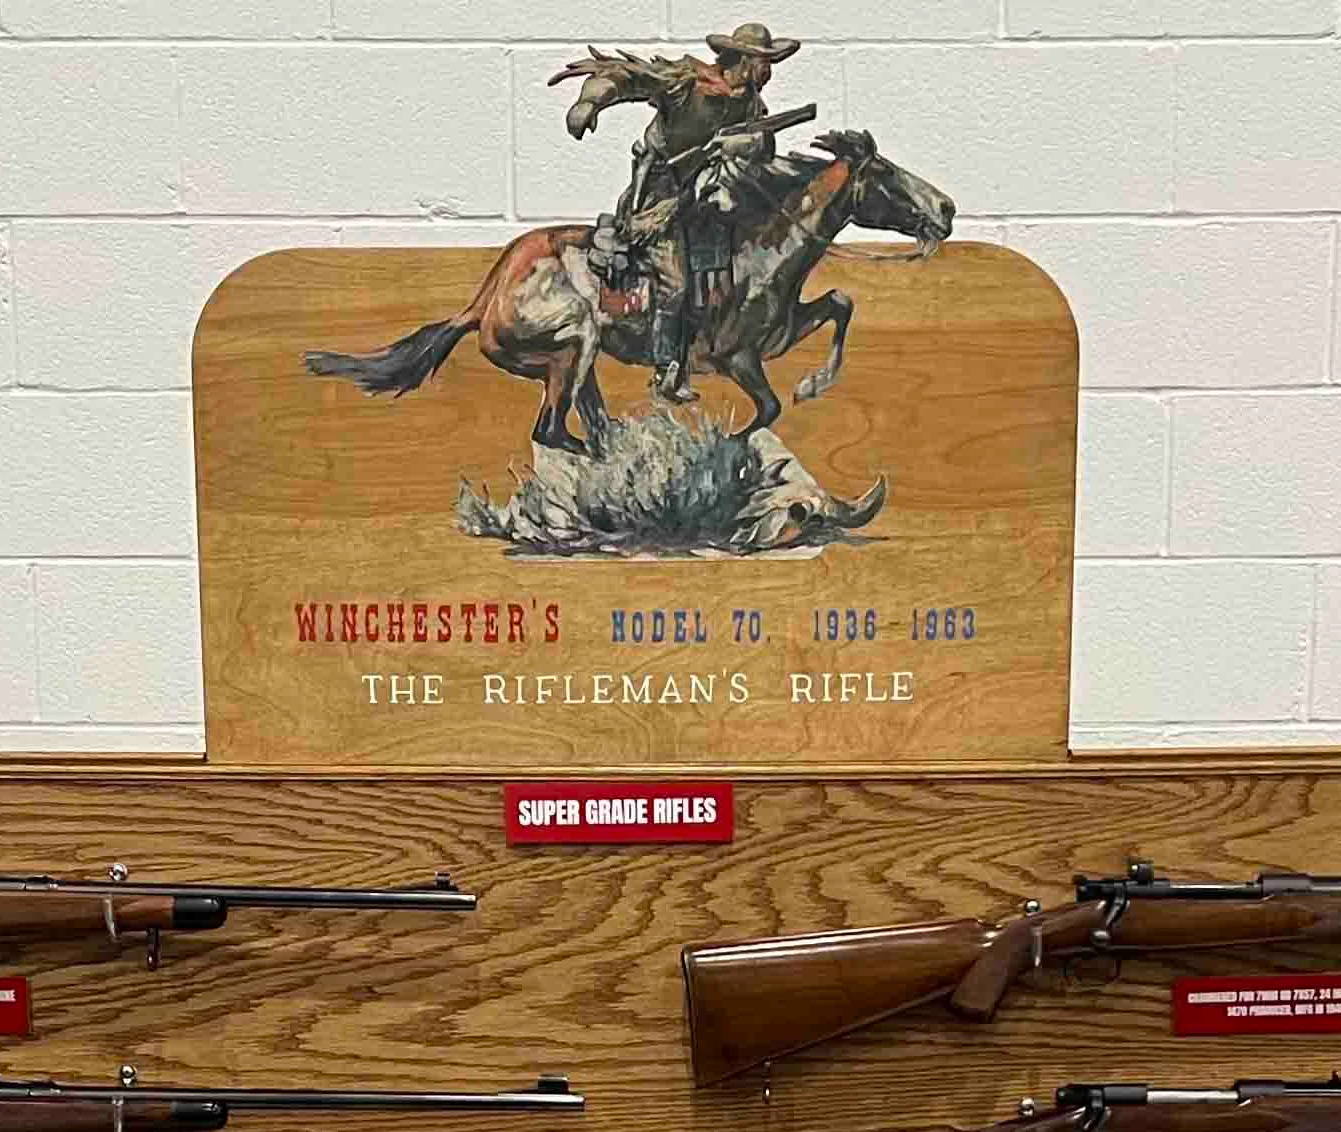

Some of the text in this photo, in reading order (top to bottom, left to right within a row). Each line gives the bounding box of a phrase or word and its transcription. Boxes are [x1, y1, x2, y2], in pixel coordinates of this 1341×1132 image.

[294, 599, 559, 643] WINCHESTER'S
[611, 609, 707, 643] MODEL
[361, 667, 914, 705] THE RIFLEMAN'S RIFLE
[518, 797, 716, 826] SUPER GRADE RIFLES
